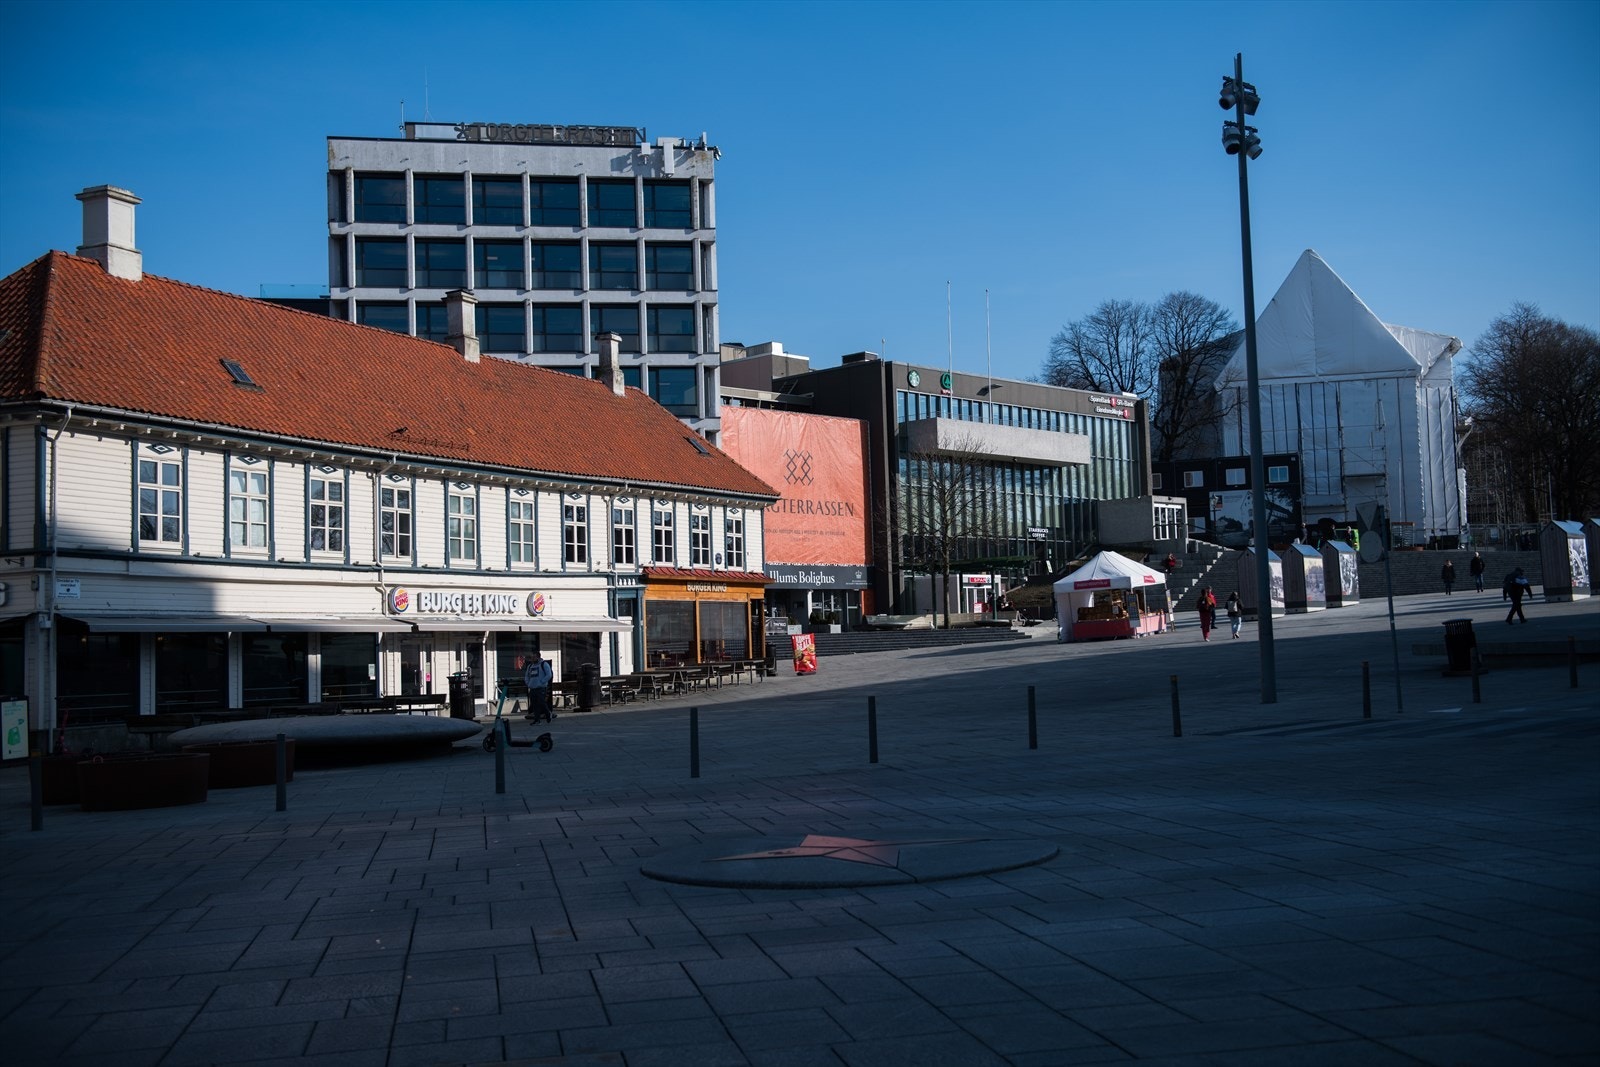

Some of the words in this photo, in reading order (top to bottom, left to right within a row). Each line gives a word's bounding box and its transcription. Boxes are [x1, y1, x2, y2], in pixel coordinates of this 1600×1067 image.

[472, 122, 647, 144] TORGTERRASSEN
[799, 570, 835, 586] Bolighus
[686, 581, 711, 592] BURGER
[712, 582, 727, 592] KING
[396, 597, 409, 608] KING
[420, 592, 483, 612] BURGER
[485, 594, 519, 613] KING
